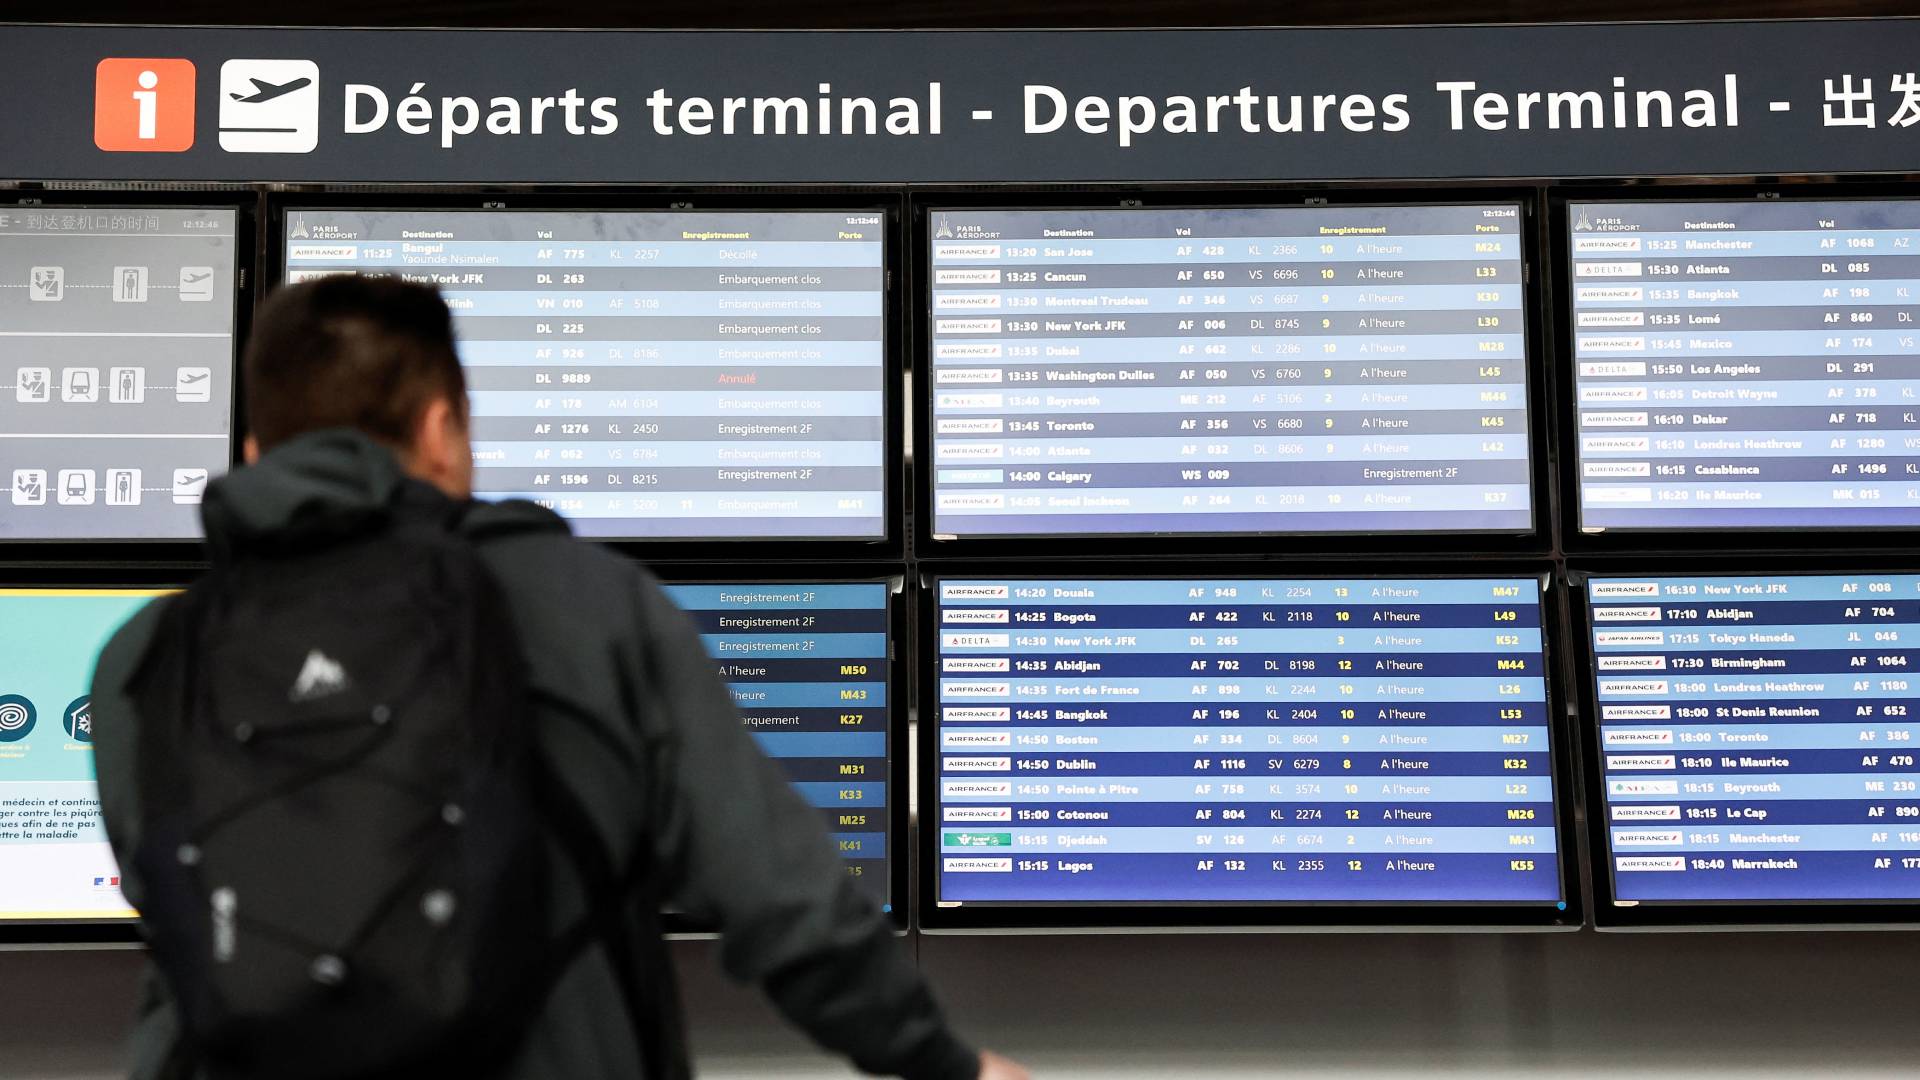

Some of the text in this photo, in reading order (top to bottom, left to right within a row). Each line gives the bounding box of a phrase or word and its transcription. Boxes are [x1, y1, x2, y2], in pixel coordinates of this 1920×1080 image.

[345, 83, 618, 148] Départs
[647, 83, 940, 135] terminal
[1025, 85, 1409, 146] Departures
[1437, 74, 1737, 130] Terminal
[1043, 224, 1500, 237] Destination Vol Enregistrement Porte
[1684, 219, 1835, 230] Destination Vol
[402, 230, 863, 241] Destination Vol Enregistrement Porte
[363, 243, 443, 259] 11:25 Bangui
[402, 254, 447, 264] Yaounde
[1006, 272, 1037, 282] 13:25
[1044, 271, 1087, 282] Cancun
[1176, 270, 1193, 281] AF
[1203, 270, 1225, 280] 650
[1248, 269, 1263, 280] VS
[1273, 269, 1299, 280] 6696
[1320, 269, 1335, 279] 10
[1357, 268, 1366, 279] A
[1368, 268, 1404, 279] l'heure
[1476, 267, 1497, 277] L33
[1593, 262, 1870, 275] DELTA 15:30 Atlanta DL 085
[401, 273, 429, 285] New
[430, 273, 460, 285] York
[461, 273, 484, 284] JFK
[536, 274, 553, 284] DL
[563, 274, 585, 284] 263
[718, 273, 799, 287] Embarquement
[800, 273, 822, 285] clos
[1649, 313, 1721, 325] 15:35 Lomé
[1007, 371, 1039, 382] 13:35
[1045, 370, 1116, 383] Washington
[1118, 369, 1155, 380] Dulles
[1179, 369, 1196, 380] AF
[1205, 369, 1228, 380] 050
[1251, 368, 1266, 379] VS
[1276, 368, 1302, 379] 6760
[1324, 368, 1332, 378] 9
[1359, 368, 1369, 378] A
[1371, 367, 1407, 378] l'heure
[1479, 366, 1501, 377] L45
[1651, 362, 1874, 377] 15:50 Los Angeles DL 291
[535, 373, 757, 385] DL 9889 Annulé
[534, 423, 813, 437] AF 1276 KL 2450 Enregistrement 2F
[1008, 467, 1458, 484] 14:00 Calgary WS 009 Enregistrement 2F
[1655, 463, 1887, 475] 16:15 Casablanca AF 1496
[719, 616, 815, 630] Enregistrement 2F
[946, 611, 1516, 625] AIRFRANCE 14:25 Bogota AF 422 KL 2118 10 A l'heure L49
[960, 636, 991, 645] DELTA
[1015, 659, 1525, 673] 14:35 Abidjan AF 702 DL 8198 12 A l'heure M44
[1671, 655, 1907, 670] 17:30 Birmingham AF 1064
[718, 665, 867, 676] A l'heure M50
[1676, 706, 1820, 718] 18:00 St Denis Reunion
[840, 714, 863, 725] K27
[1016, 759, 1528, 770] 14:50 Dublin AF 1116 SV 6279 8 K32
[3, 798, 44, 806] médecin
[54, 809, 67, 817] les
[1686, 807, 1767, 821] 18:15 Le Cap
[22, 820, 41, 828] afin
[46, 820, 58, 828] de
[78, 821, 95, 830] pas
